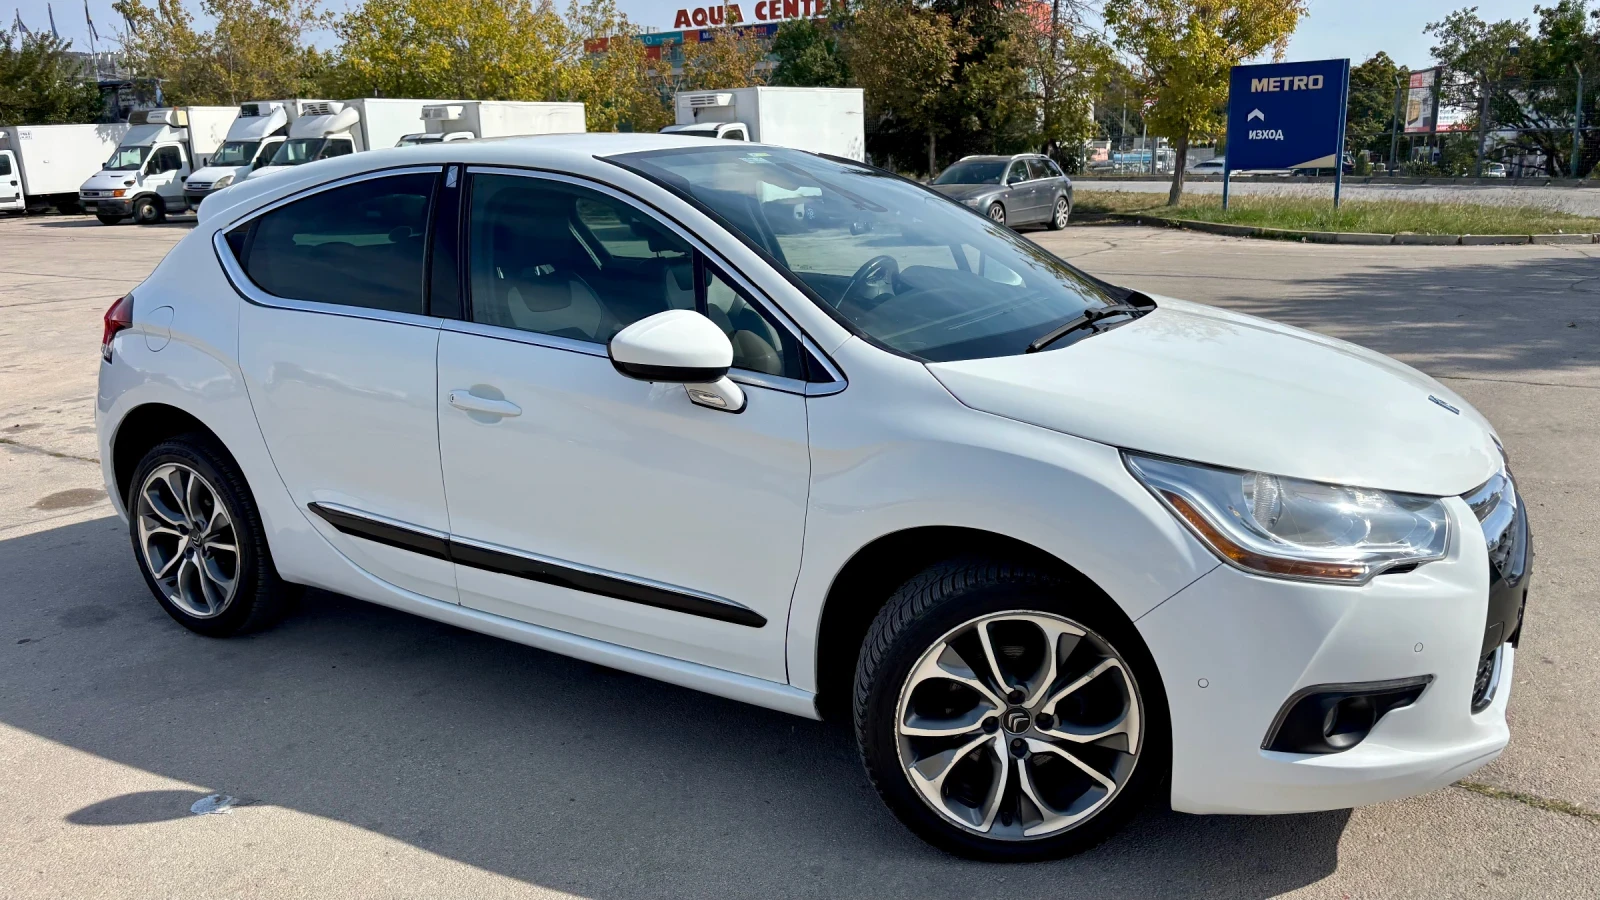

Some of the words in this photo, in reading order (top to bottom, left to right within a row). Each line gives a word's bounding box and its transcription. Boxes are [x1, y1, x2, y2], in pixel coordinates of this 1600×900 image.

[674, 3, 744, 28] AQUA
[1251, 75, 1324, 92] METRO
[1248, 129, 1284, 141] ИЗХОД
